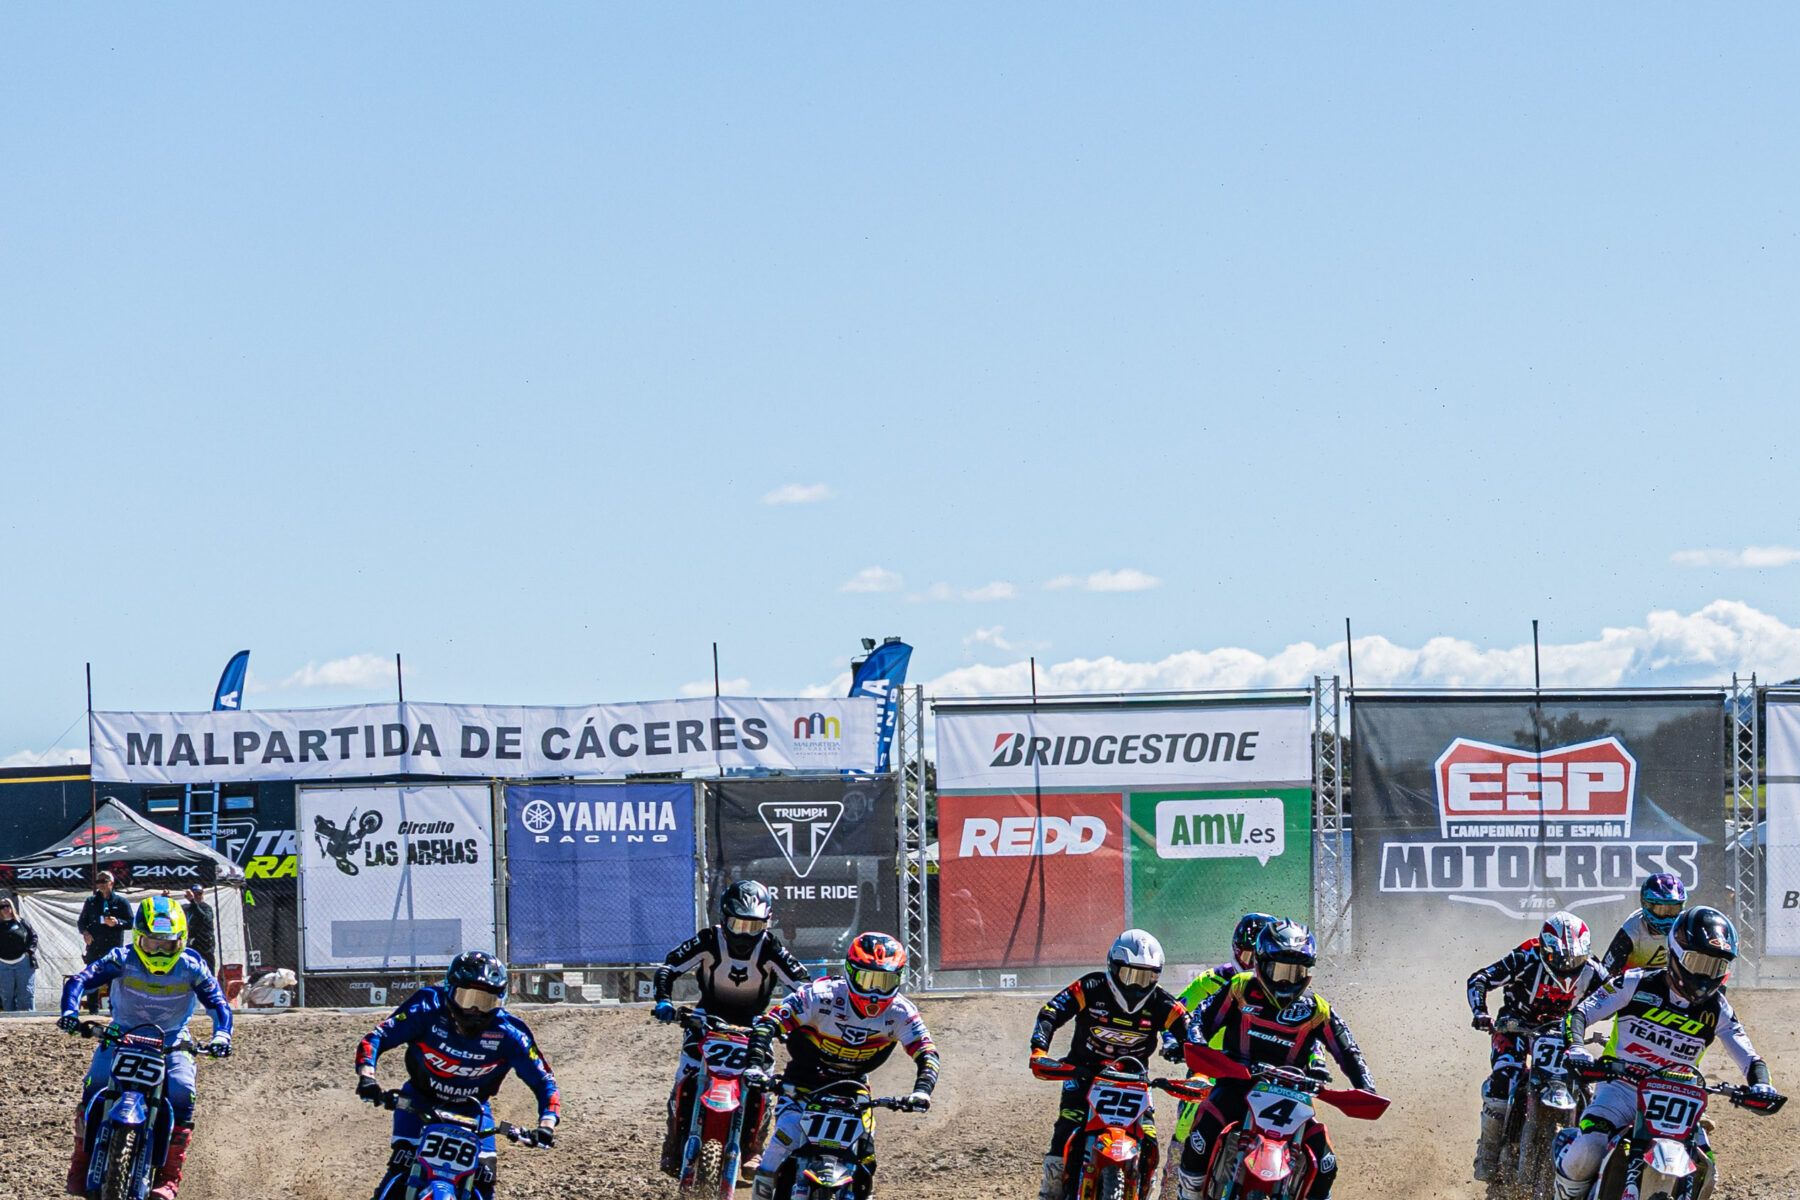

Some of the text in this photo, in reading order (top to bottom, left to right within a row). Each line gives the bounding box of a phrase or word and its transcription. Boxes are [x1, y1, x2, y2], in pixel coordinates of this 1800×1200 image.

[127, 716, 768, 766] MALPARTIDA DE CÁCERES
[990, 731, 1259, 767] BRIDGESTONE
[1447, 762, 1625, 813] ESP
[557, 801, 677, 832] YAMAHA
[774, 808, 828, 819] TRIUMPH
[398, 821, 454, 835] Circuito
[535, 834, 668, 843] RACING
[959, 815, 1105, 857] REDD
[1451, 820, 1622, 837] CAMPEONATO DE ESPAÑA
[365, 839, 478, 867] LAS ARENAS
[18, 867, 83, 879] 24MX
[132, 865, 199, 877] 24MX
[1382, 844, 1697, 889] MOTOCROSS
[784, 886, 815, 900] THE
[820, 885, 858, 899] RIDE
[553, 986, 561, 996] 8
[1002, 977, 1016, 987] 13
[279, 990, 287, 1005] 5
[374, 990, 382, 1001] 6
[1629, 1022, 1674, 1046] TEAM
[1642, 1007, 1705, 1035] UFO
[112, 1054, 165, 1084] 85
[429, 1077, 480, 1097] YAMAHA
[1268, 1085, 1307, 1102] MOTOREX
[1096, 1089, 1144, 1119] 25
[1258, 1099, 1298, 1128] 4
[1646, 1095, 1698, 1126] 501
[806, 1113, 861, 1142] 111
[419, 1134, 478, 1169] 368
